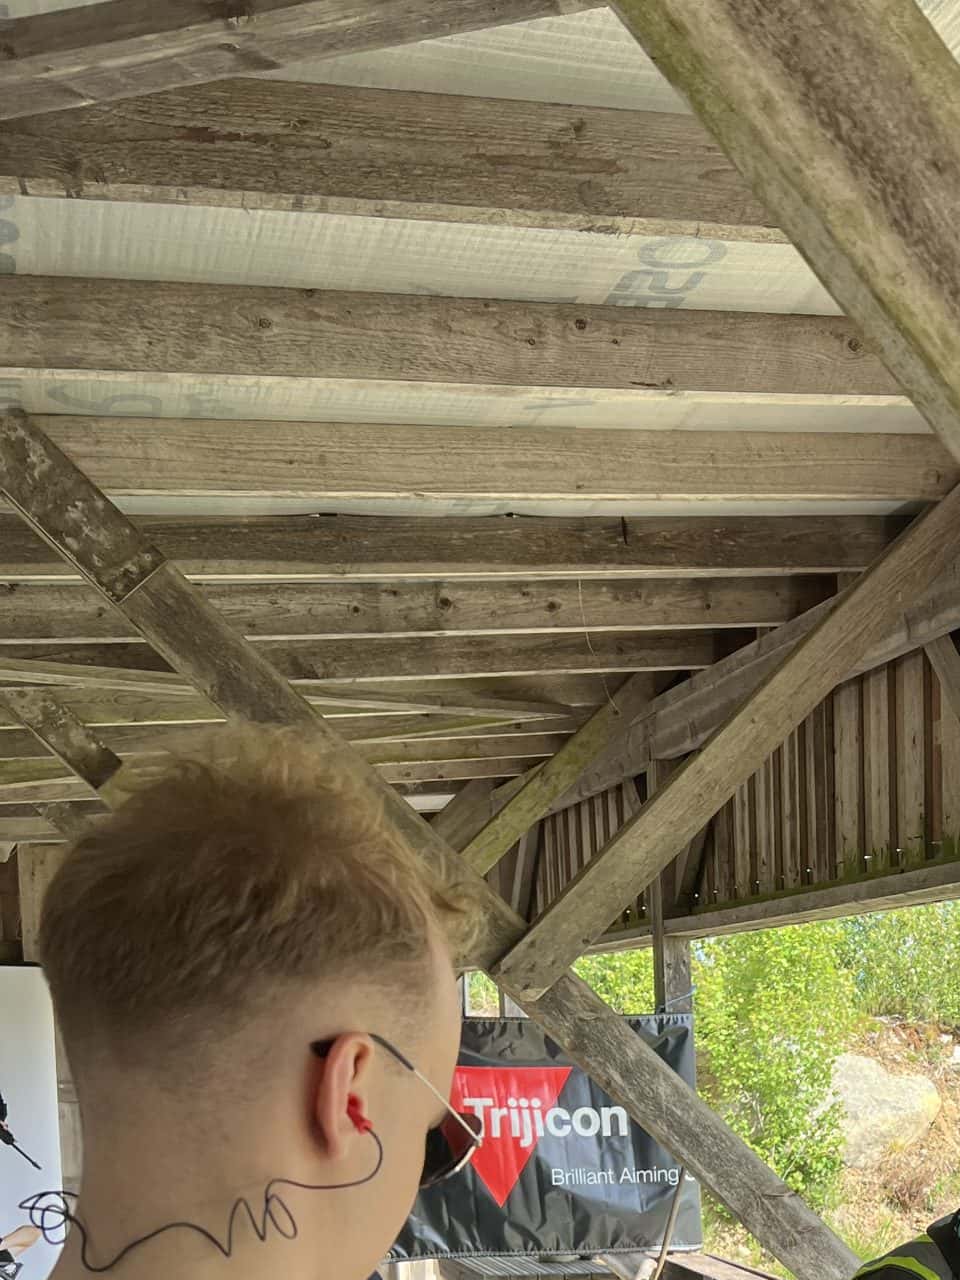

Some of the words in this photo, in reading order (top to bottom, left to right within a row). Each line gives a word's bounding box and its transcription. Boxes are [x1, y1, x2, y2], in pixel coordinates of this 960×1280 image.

[463, 1097, 628, 1148] Trijicon
[551, 1168, 613, 1186] Brilliant
[619, 1166, 679, 1186] Aiming
